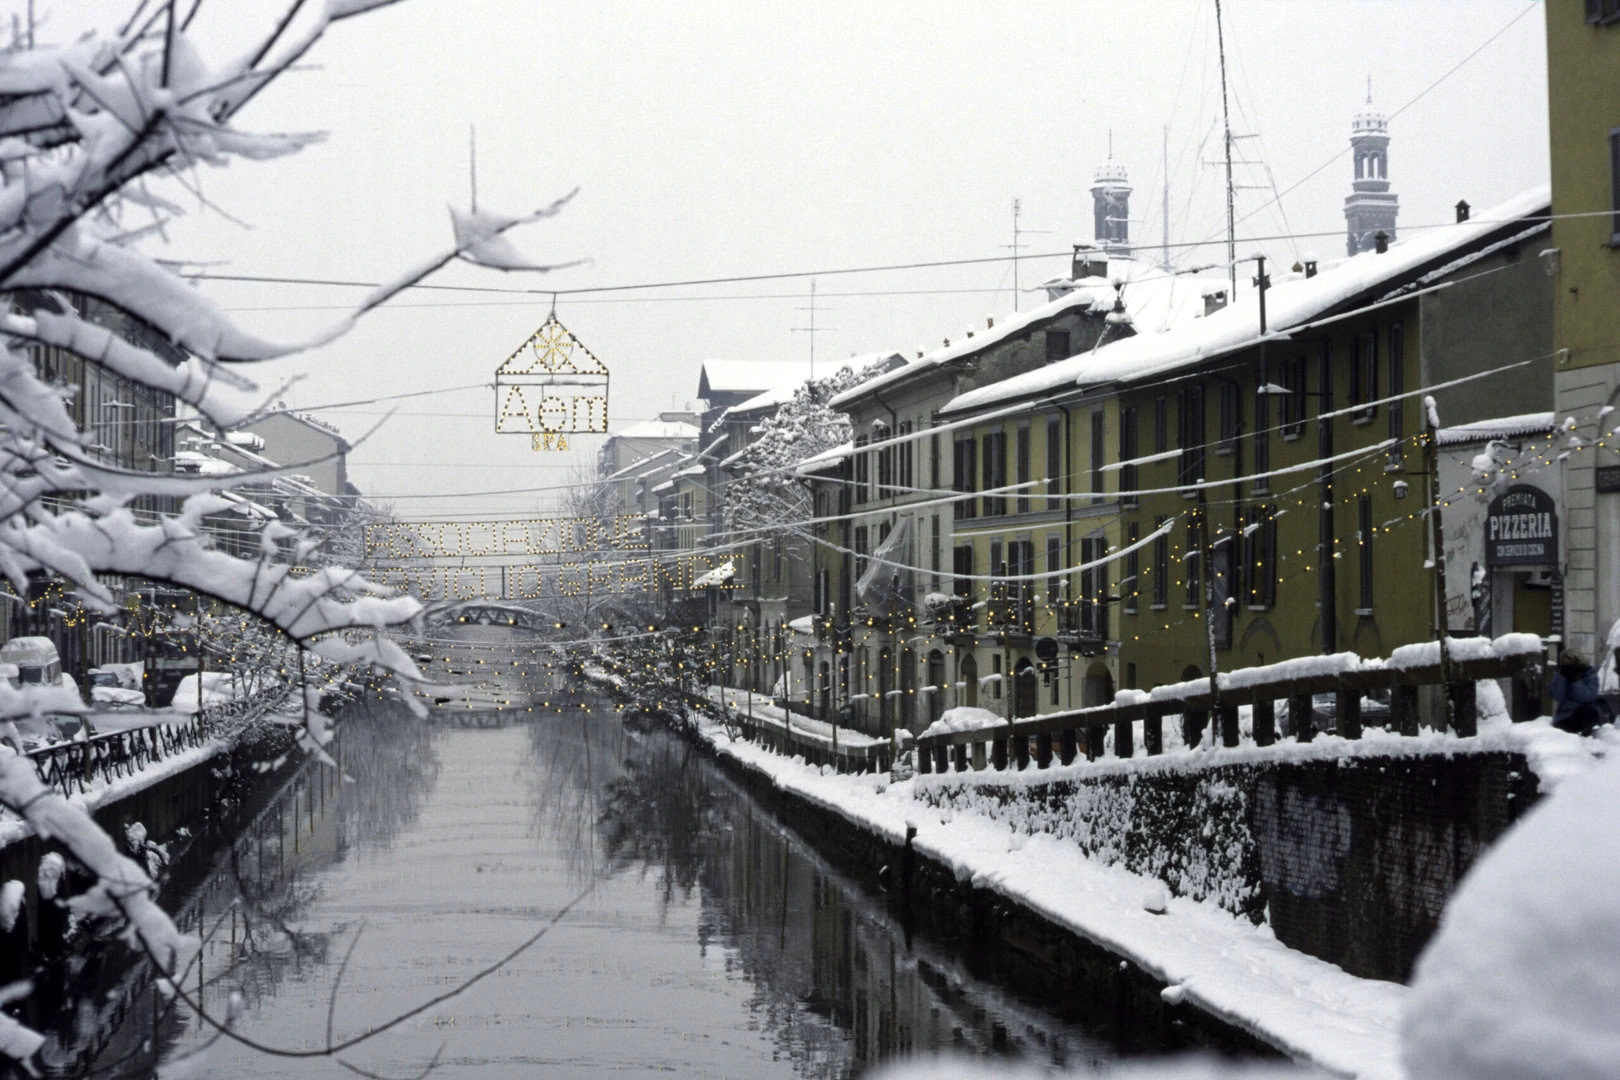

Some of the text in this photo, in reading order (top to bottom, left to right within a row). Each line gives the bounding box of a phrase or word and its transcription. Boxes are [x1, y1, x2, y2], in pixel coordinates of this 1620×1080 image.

[532, 433, 569, 451] SPA
[1502, 492, 1536, 512] PREMIATA
[366, 514, 649, 558] ASSOCIAZIONE
[1489, 512, 1552, 540] PIZZERIA
[559, 553, 745, 596] GRANDE
